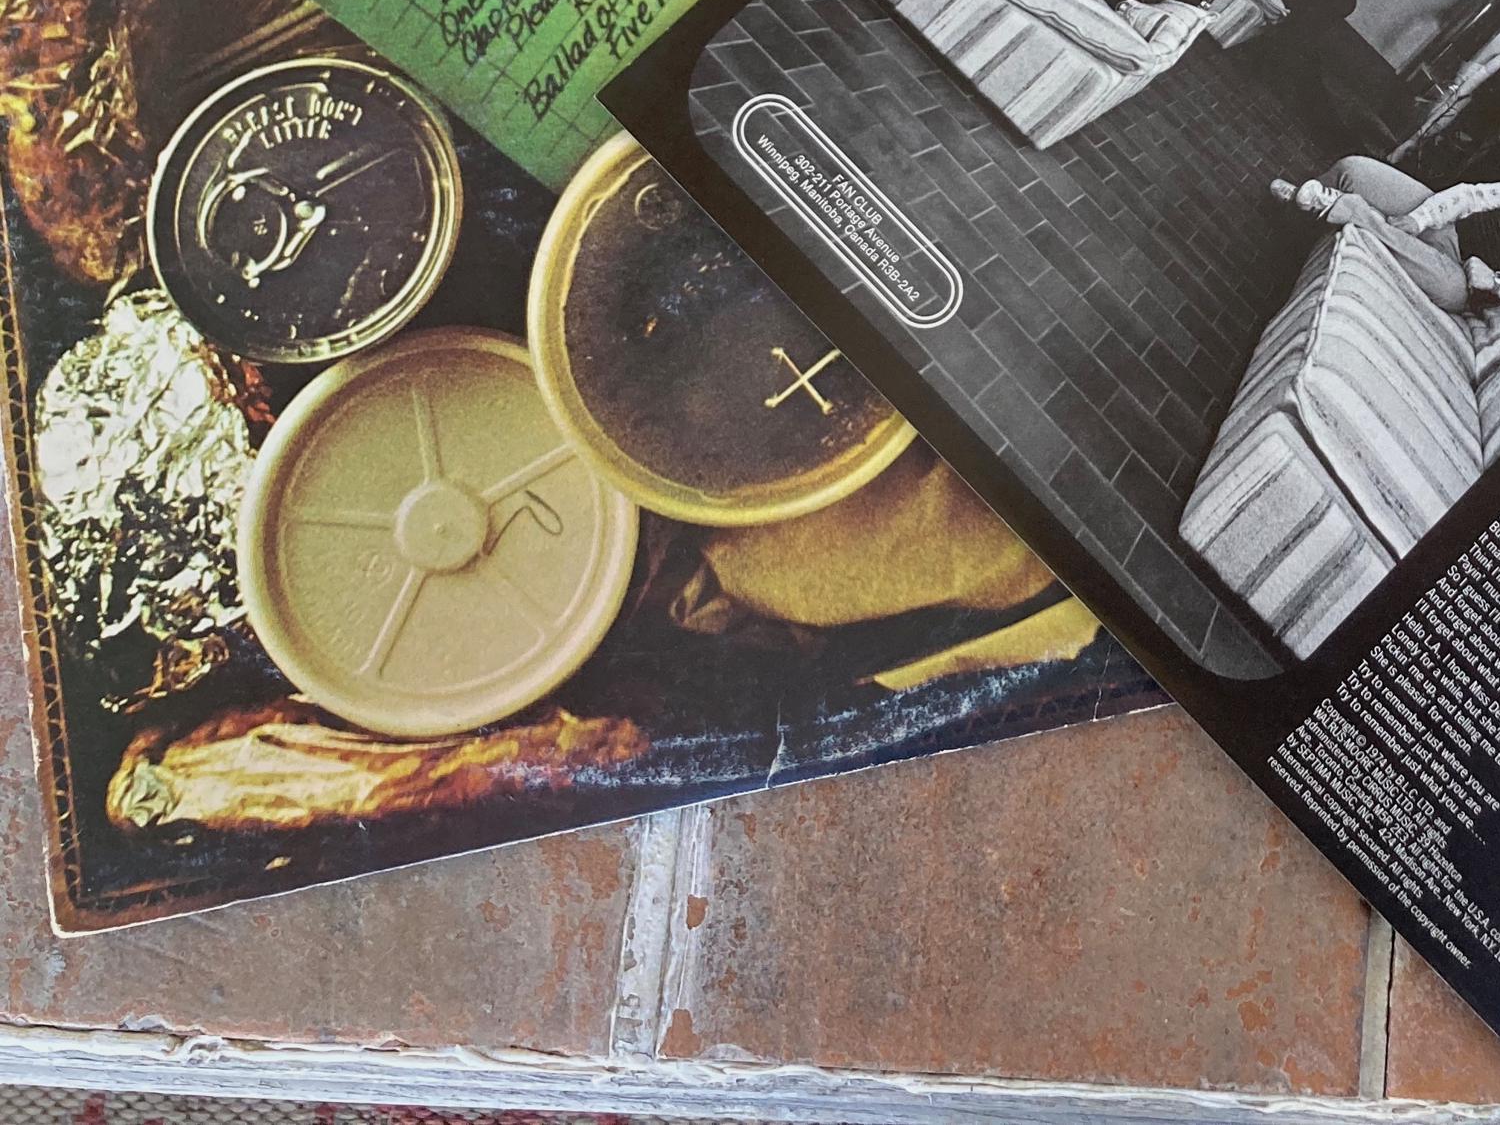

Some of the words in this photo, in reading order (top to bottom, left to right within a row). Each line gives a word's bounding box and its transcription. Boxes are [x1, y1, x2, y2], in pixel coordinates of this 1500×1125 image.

[523, 29, 601, 122] Ballad
[754, 134, 804, 184] Winnipeg,
[798, 178, 847, 228] Manitoba,
[842, 223, 881, 262] Canada
[876, 258, 920, 302] R3B-2A2
[793, 153, 832, 193] 302-211
[827, 189, 868, 230] Portage
[863, 225, 901, 264] Avenue
[831, 173, 856, 198] FAN
[852, 194, 883, 225] CLUB
[1469, 541, 1493, 571] Think
[1401, 611, 1425, 638] Hello
[1423, 633, 1440, 659] L.A.,
[1446, 657, 1470, 685] hope
[1468, 680, 1490, 705] Miss
[1357, 658, 1373, 678] Try
[1370, 674, 1382, 689] to
[1381, 686, 1426, 732] remember
[1421, 729, 1443, 751] just
[1440, 747, 1468, 778] where
[1464, 774, 1485, 795] you
[1483, 792, 1500, 811] are
[1365, 743, 1387, 767] 1974
[1380, 763, 1396, 781] by
[1394, 774, 1418, 801] B.L.C.
[1416, 796, 1434, 819] LTD.
[1433, 816, 1452, 835] and
[1370, 766, 1399, 797] MUSIC
[1395, 792, 1413, 815] LTD.
[1412, 811, 1427, 826] All
[1422, 823, 1447, 849] rights
[1266, 755, 1303, 794] reserved.
[1301, 789, 1340, 831] Reprinted
[1336, 826, 1349, 842] by
[1345, 839, 1389, 884] permission
[1387, 882, 1400, 893] of
[1396, 889, 1411, 907] the
[1410, 905, 1447, 944] copyright
[1445, 941, 1471, 969] owner.
